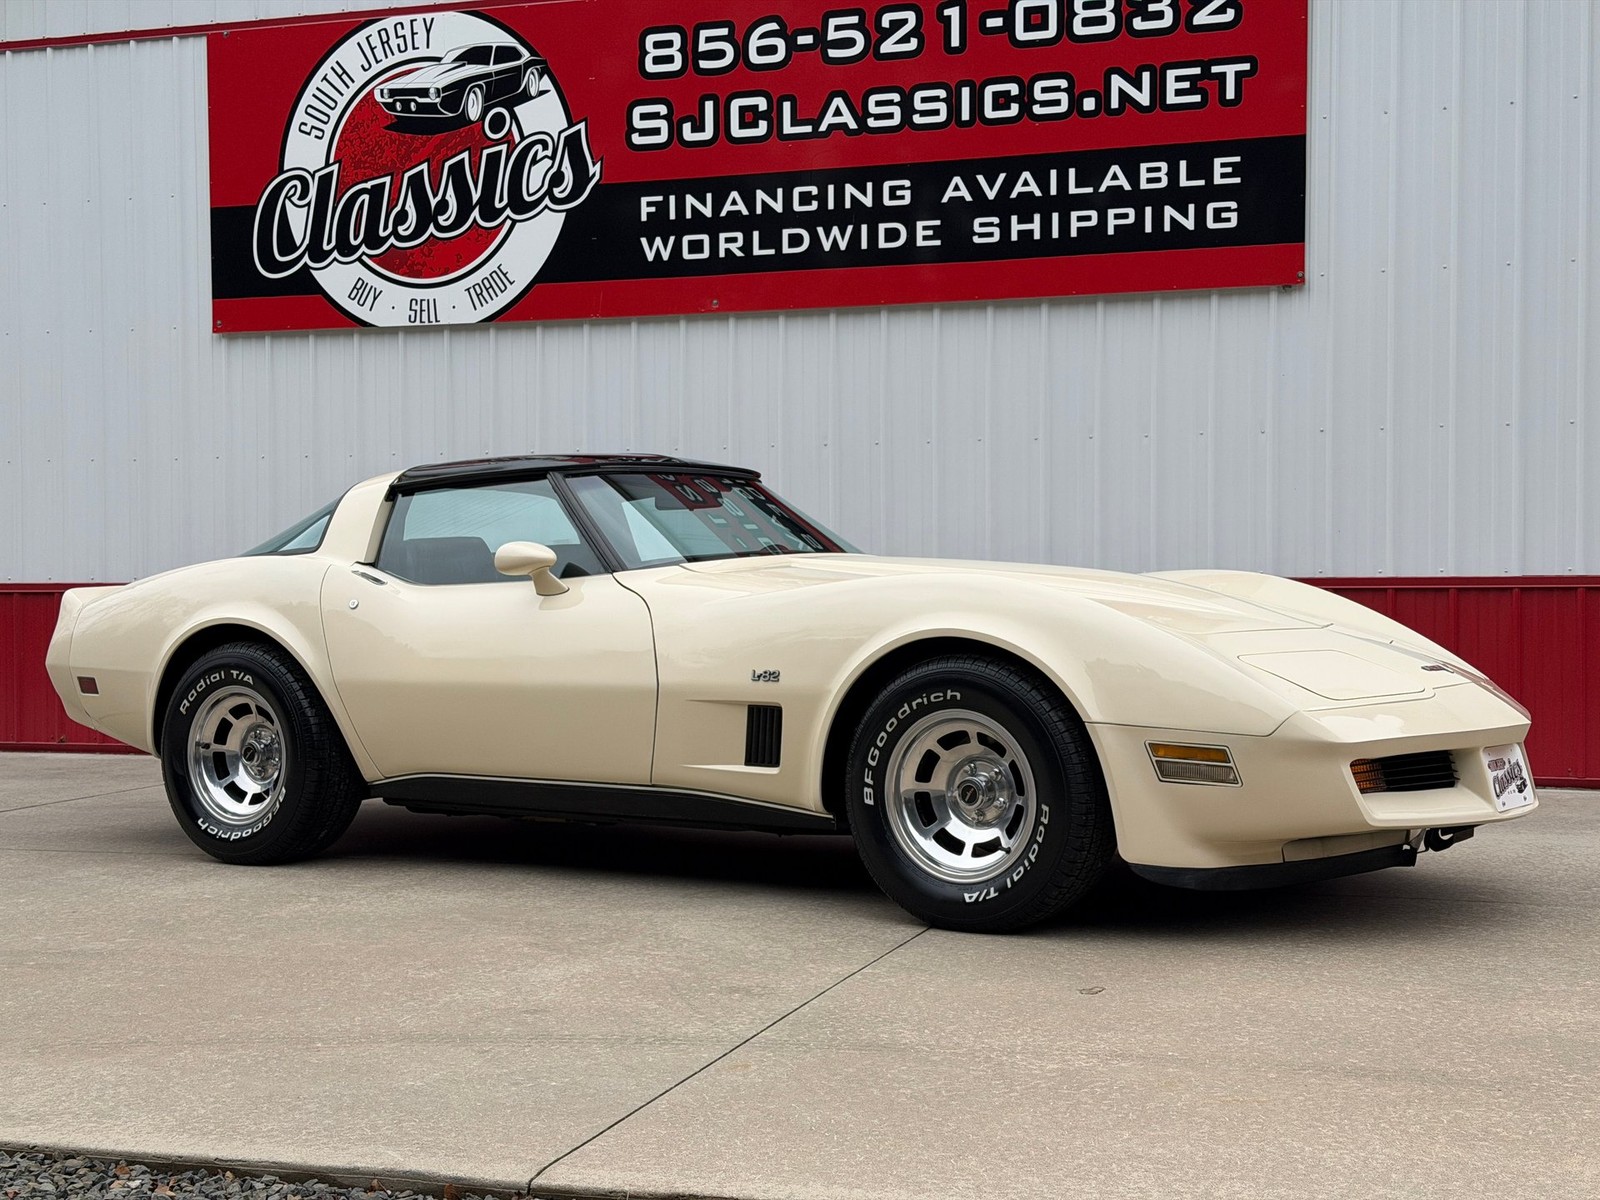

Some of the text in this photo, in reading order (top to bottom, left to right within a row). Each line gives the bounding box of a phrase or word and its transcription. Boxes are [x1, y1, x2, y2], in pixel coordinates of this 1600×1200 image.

[642, 0, 1237, 75] 856-521-0832
[298, 17, 435, 140] SOUTH JERSEY
[630, 61, 1251, 146] SJCLASSICS.NET
[253, 106, 604, 280] Classics
[639, 156, 1242, 222] FINANCING AVAILABLE
[639, 201, 1240, 262] WORLDWIDE SHIPPING
[348, 263, 516, 324] BUY SELL TRADE
[179, 669, 254, 715] Radial T/A
[864, 689, 961, 806] BFGoodrich
[963, 803, 1050, 903] Radial T/A
